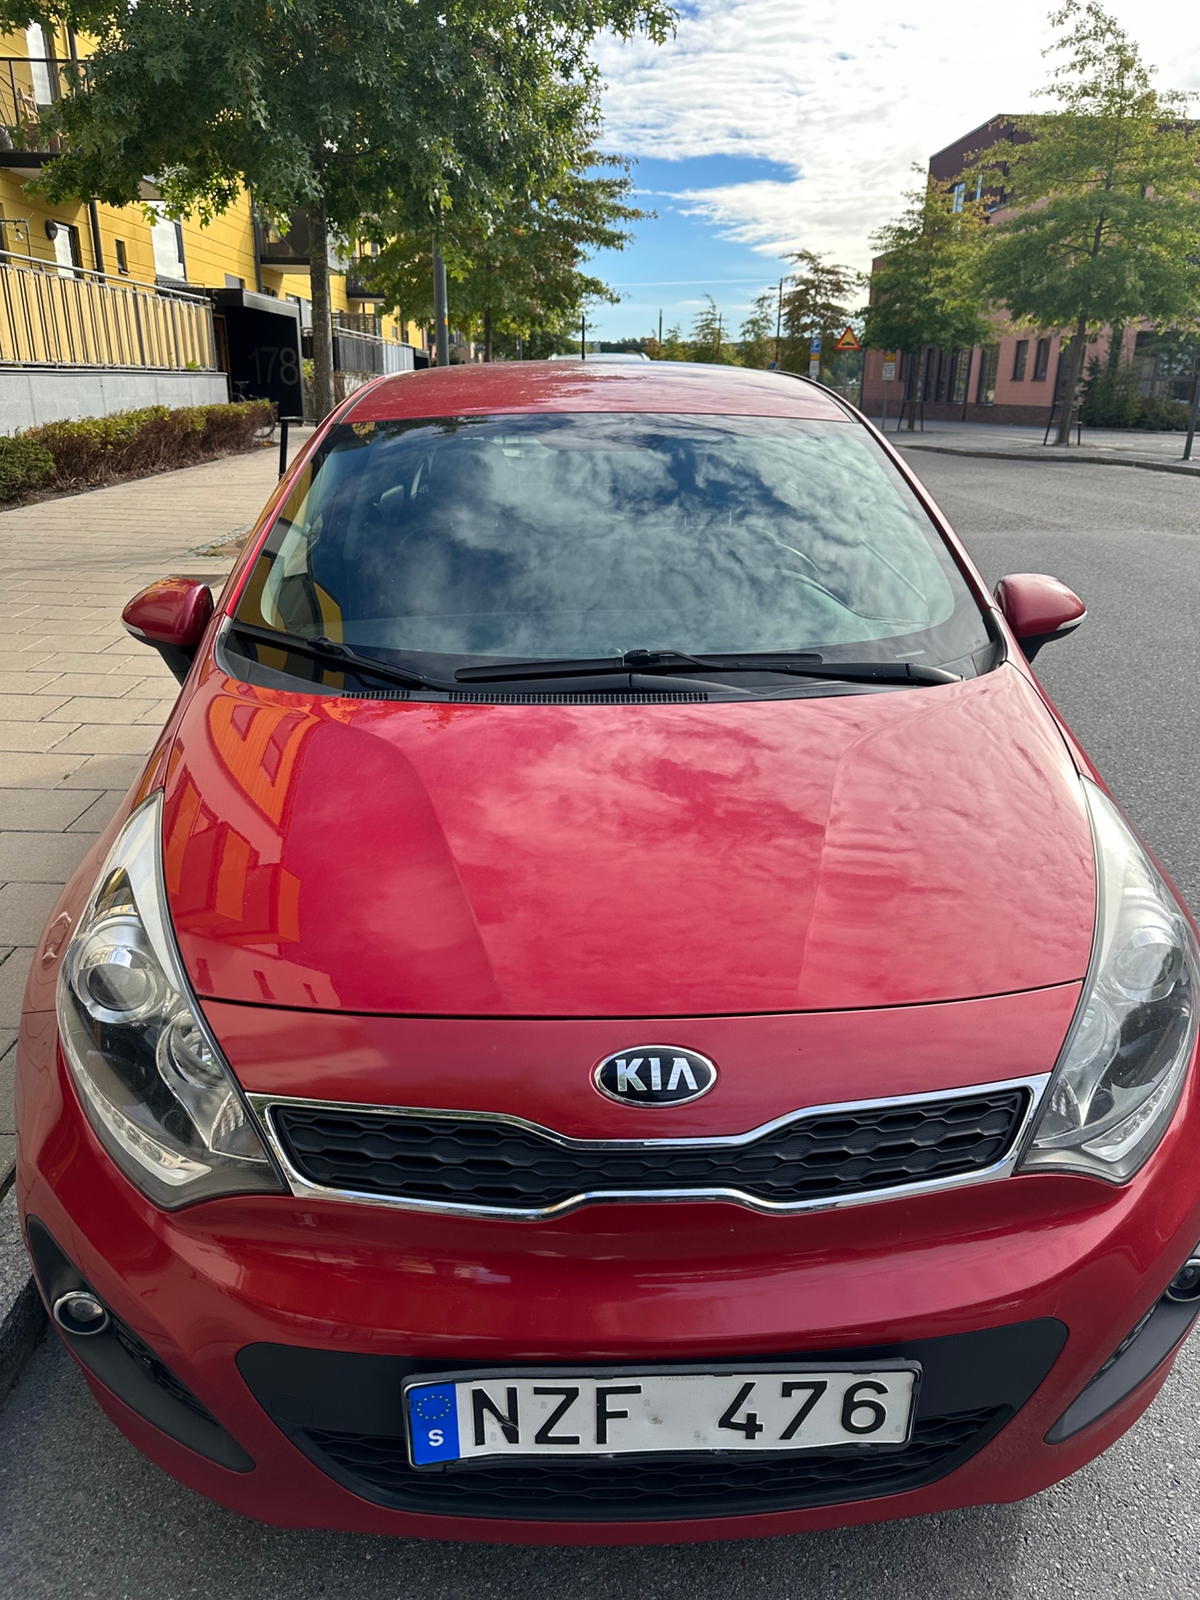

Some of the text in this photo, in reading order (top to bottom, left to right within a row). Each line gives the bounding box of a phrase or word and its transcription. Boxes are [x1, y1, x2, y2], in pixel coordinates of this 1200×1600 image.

[248, 346, 300, 386] 178
[615, 1057, 699, 1092] KIA
[471, 1379, 889, 1446] NZF 476
[428, 1428, 445, 1447] S
